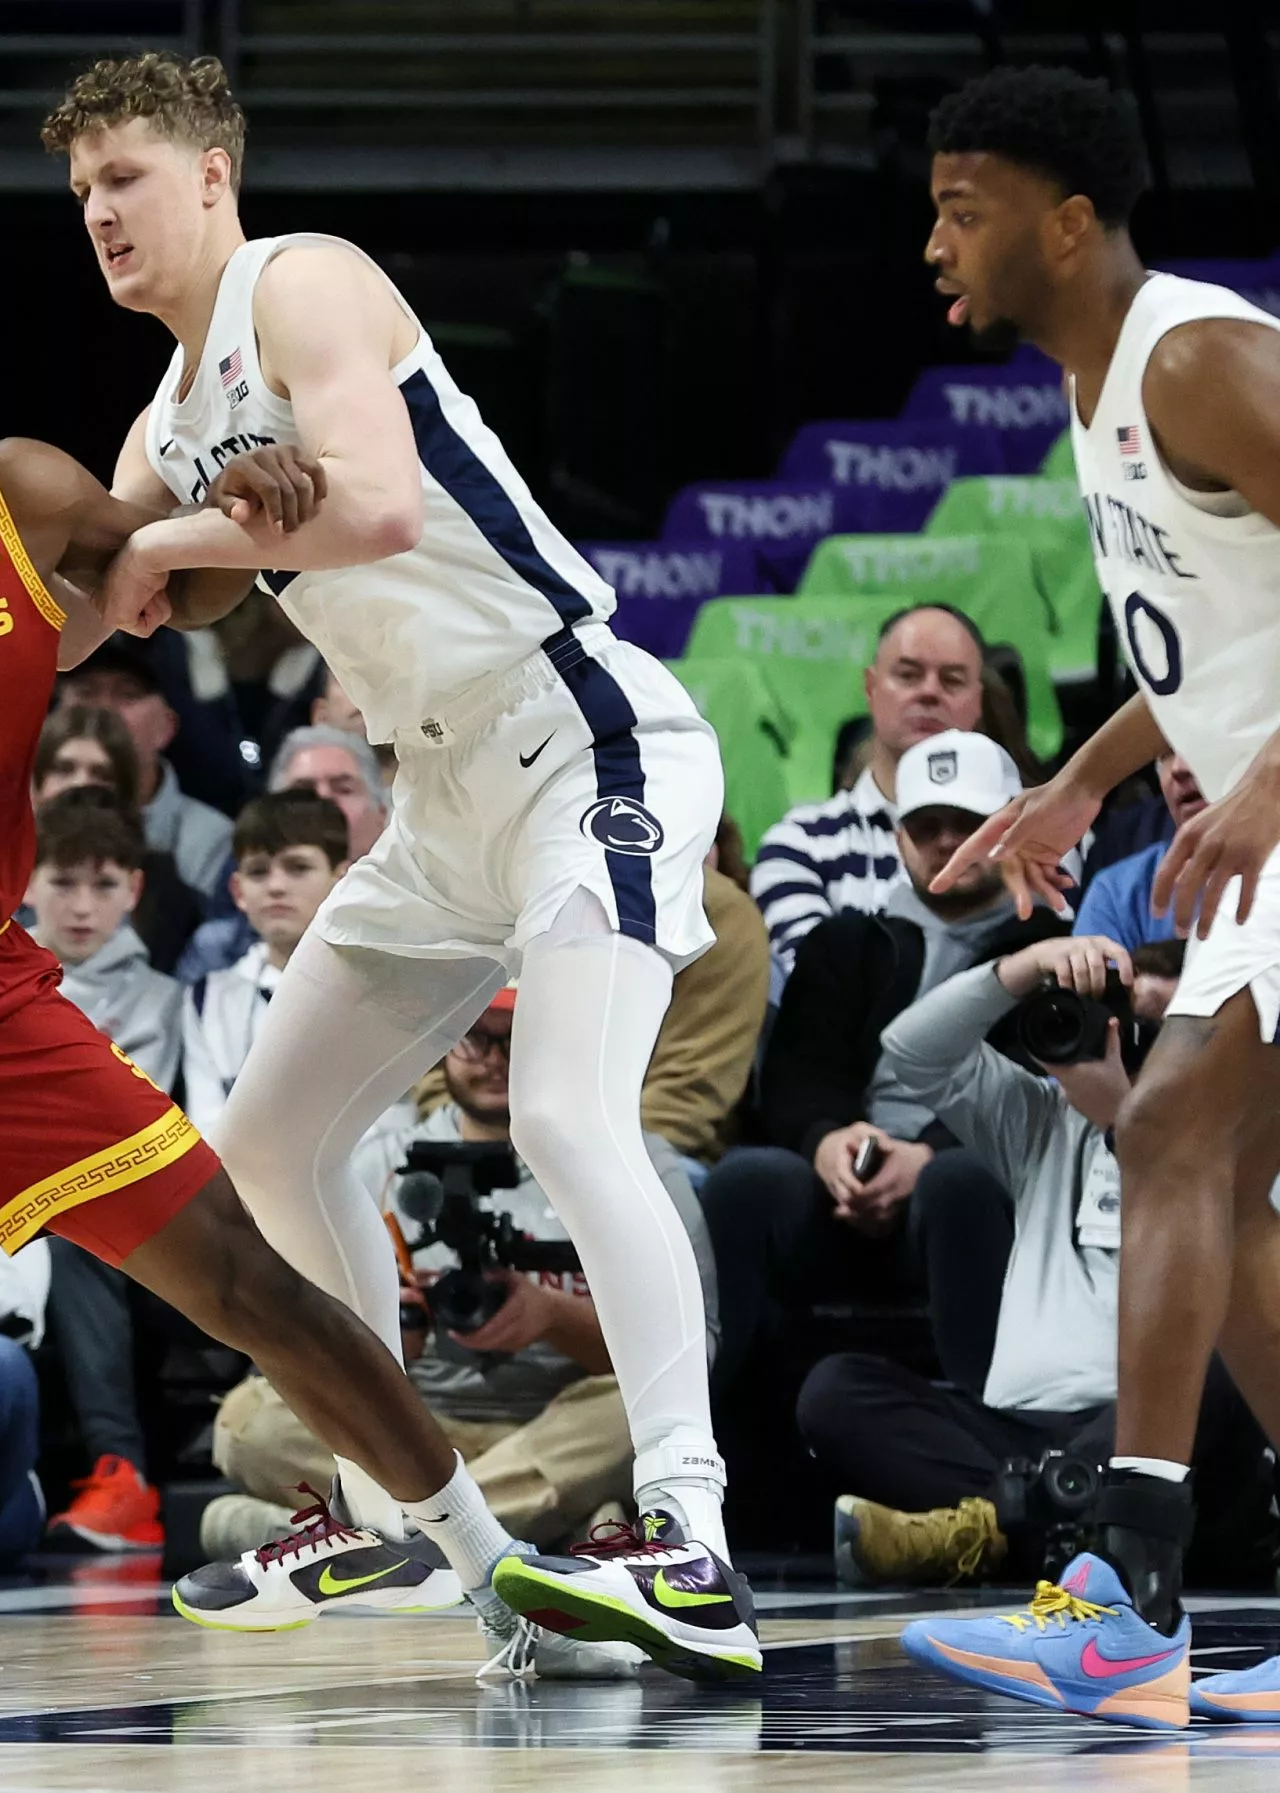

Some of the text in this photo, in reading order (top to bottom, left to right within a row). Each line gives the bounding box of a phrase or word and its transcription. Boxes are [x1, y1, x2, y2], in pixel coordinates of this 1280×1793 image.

[825, 440, 957, 489] THON
[697, 491, 834, 539] THON
[593, 548, 722, 599] THON
